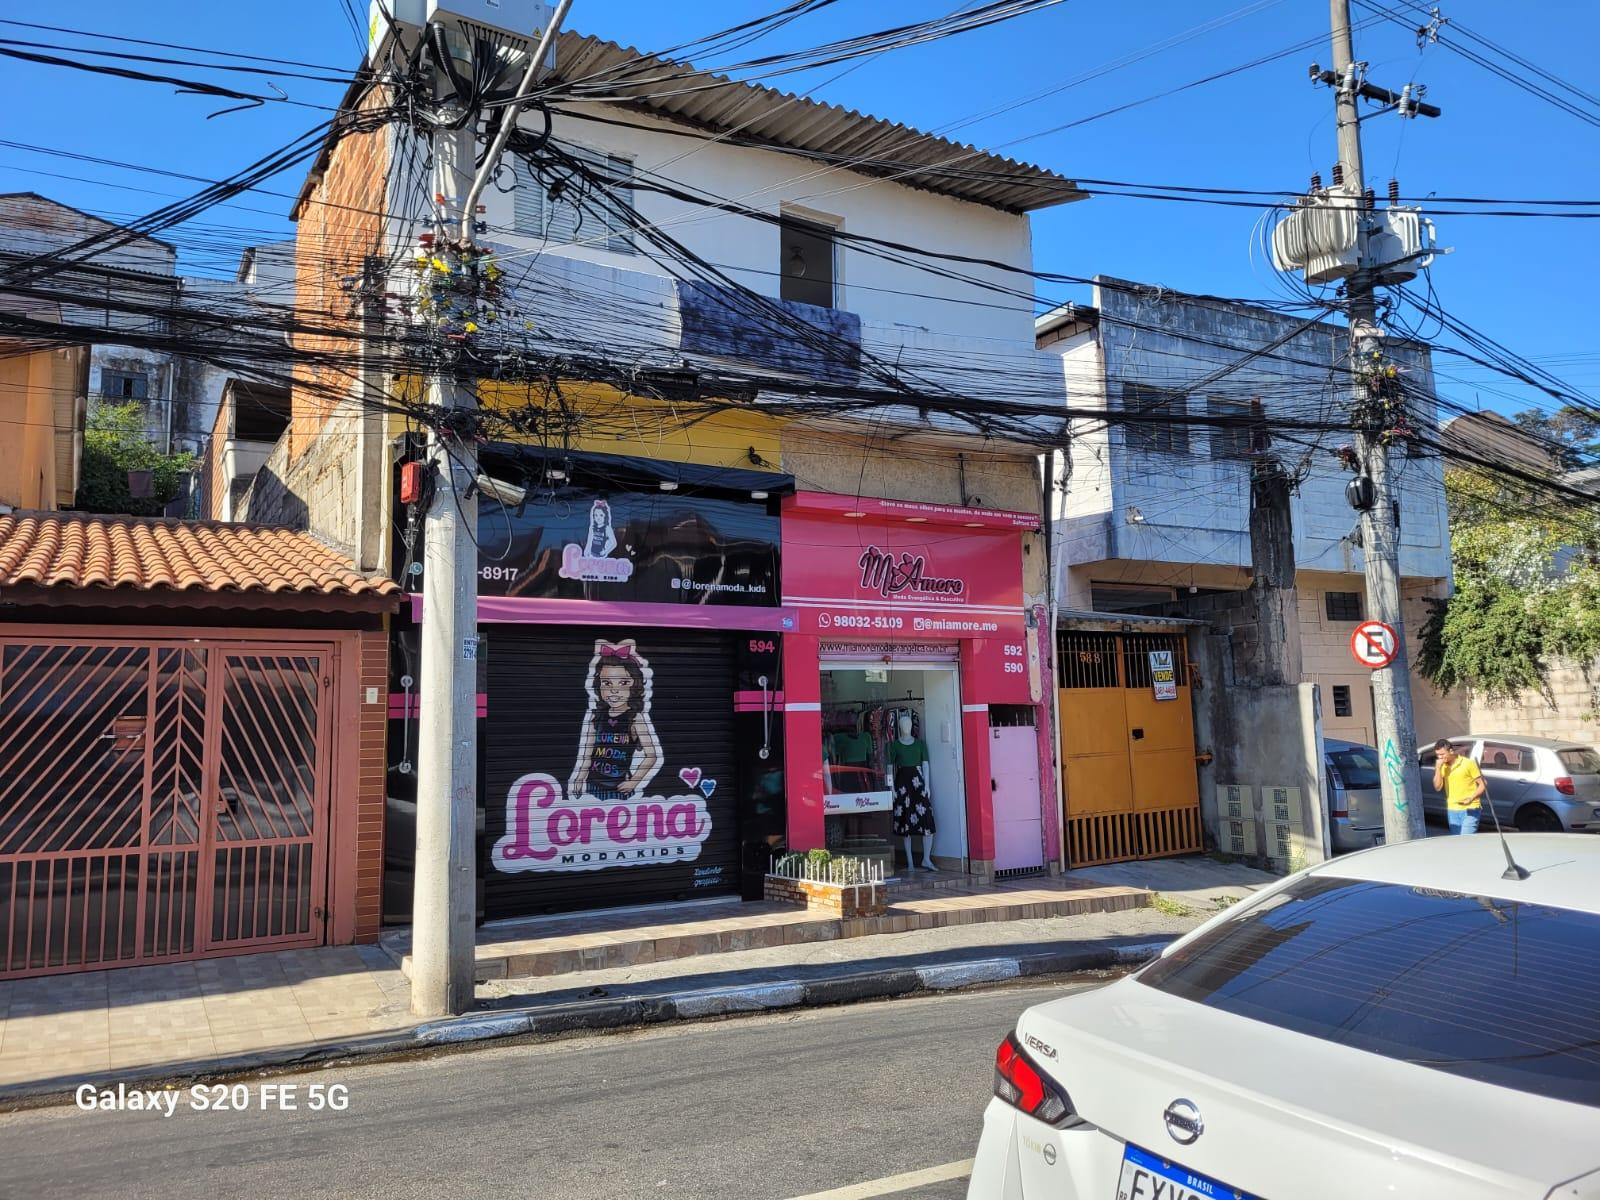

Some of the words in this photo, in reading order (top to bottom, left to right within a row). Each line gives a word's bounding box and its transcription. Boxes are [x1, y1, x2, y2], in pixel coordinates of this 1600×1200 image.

[833, 615, 903, 628] 98032-5109
[750, 640, 775, 653] 594
[1004, 644, 1023, 656] 592
[1004, 663, 1023, 673] 590
[502, 779, 705, 861] Lorena
[562, 852, 626, 863] MODA
[637, 847, 684, 858] KIDS
[1025, 1032, 1058, 1063] VERSA
[1187, 1175, 1213, 1194] BRASIL
